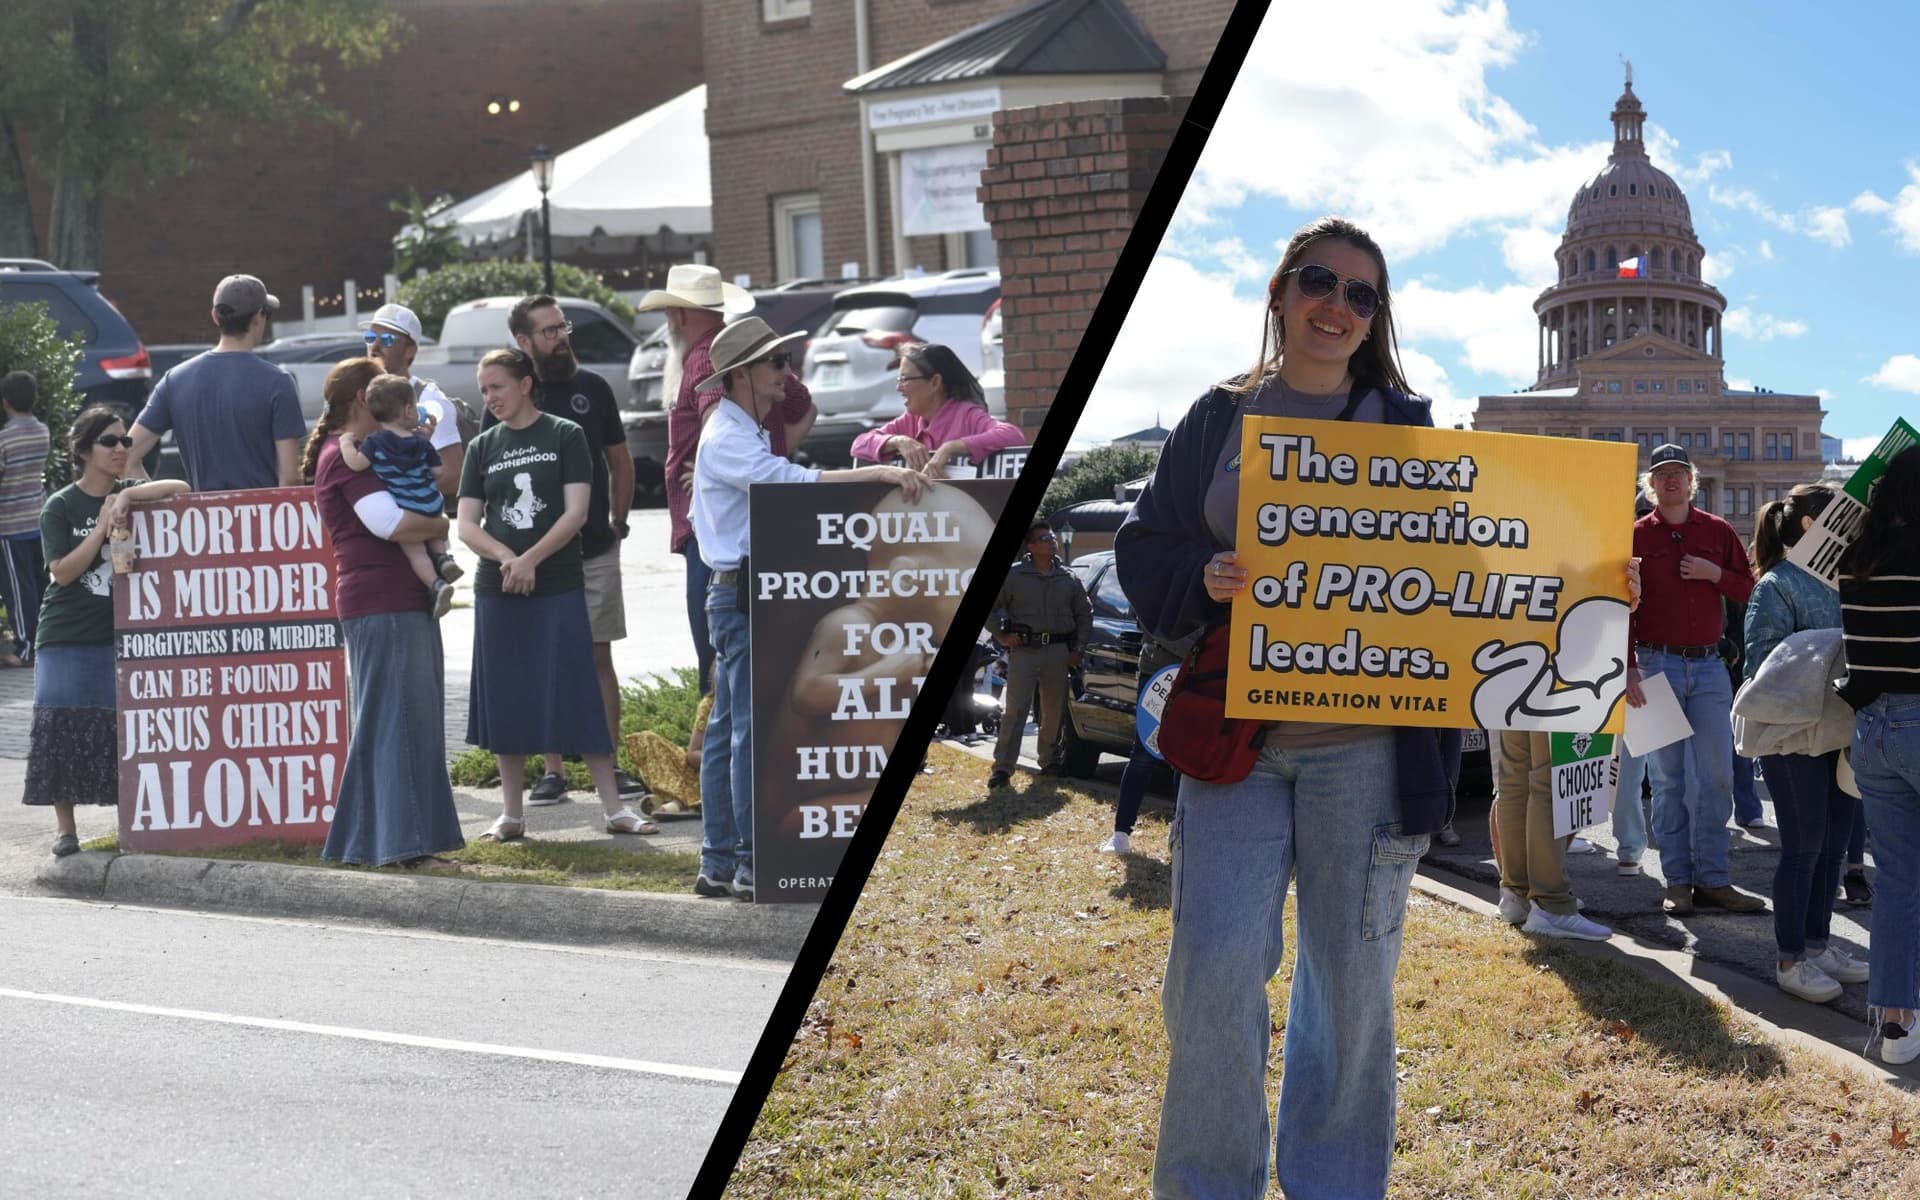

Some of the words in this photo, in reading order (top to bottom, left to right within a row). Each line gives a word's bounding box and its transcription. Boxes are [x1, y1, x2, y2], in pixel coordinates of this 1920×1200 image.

[487, 452, 557, 474] MOTHERHOOD
[1260, 433, 1358, 484] The
[1368, 455, 1478, 492] next
[131, 500, 323, 559] ABORTION
[816, 511, 960, 551] EQUAL
[1257, 502, 1528, 549] generation
[127, 570, 161, 621] IS
[174, 562, 329, 618] MURDER
[1253, 561, 1308, 608] of
[1314, 564, 1563, 622] PRO-LIFE
[123, 629, 227, 658] FORGIVENESS
[232, 626, 265, 652] FOR
[269, 623, 336, 649] MURDER
[842, 622, 939, 656] FOR
[1249, 624, 1449, 680] leaders.
[130, 669, 173, 700] CAN
[181, 667, 213, 698] BE
[220, 663, 299, 696] FOUND
[307, 661, 332, 691] IN
[1247, 688, 1381, 710] GENERATION
[1390, 694, 1448, 713] VITAE
[122, 705, 211, 761] JESUS
[222, 699, 342, 750] CHRIST
[131, 753, 336, 832] ALONE!
[1558, 760, 1604, 799] CHOOSE
[1570, 796, 1593, 831] LIFE
